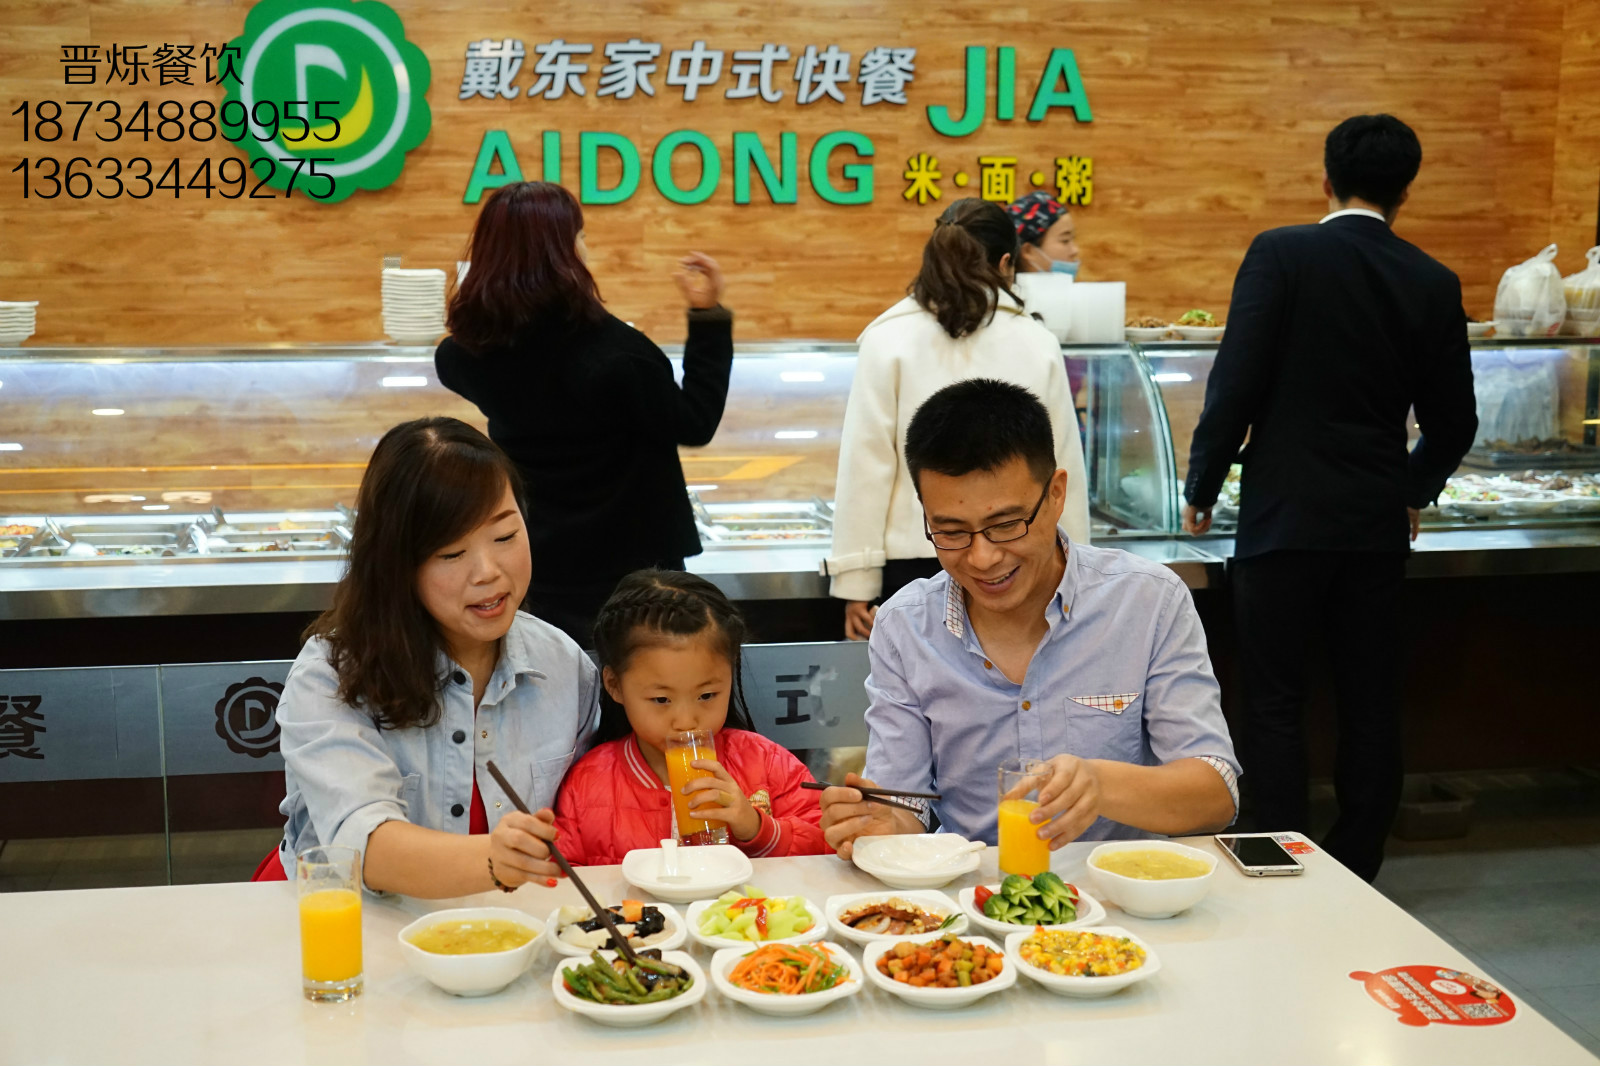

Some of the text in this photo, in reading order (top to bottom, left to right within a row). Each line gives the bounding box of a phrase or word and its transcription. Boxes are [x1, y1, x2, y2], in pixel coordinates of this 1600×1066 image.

[459, 39, 917, 106] 戴东家中式快餐
[926, 46, 1094, 137] JIA
[463, 129, 876, 206] AIDONG
